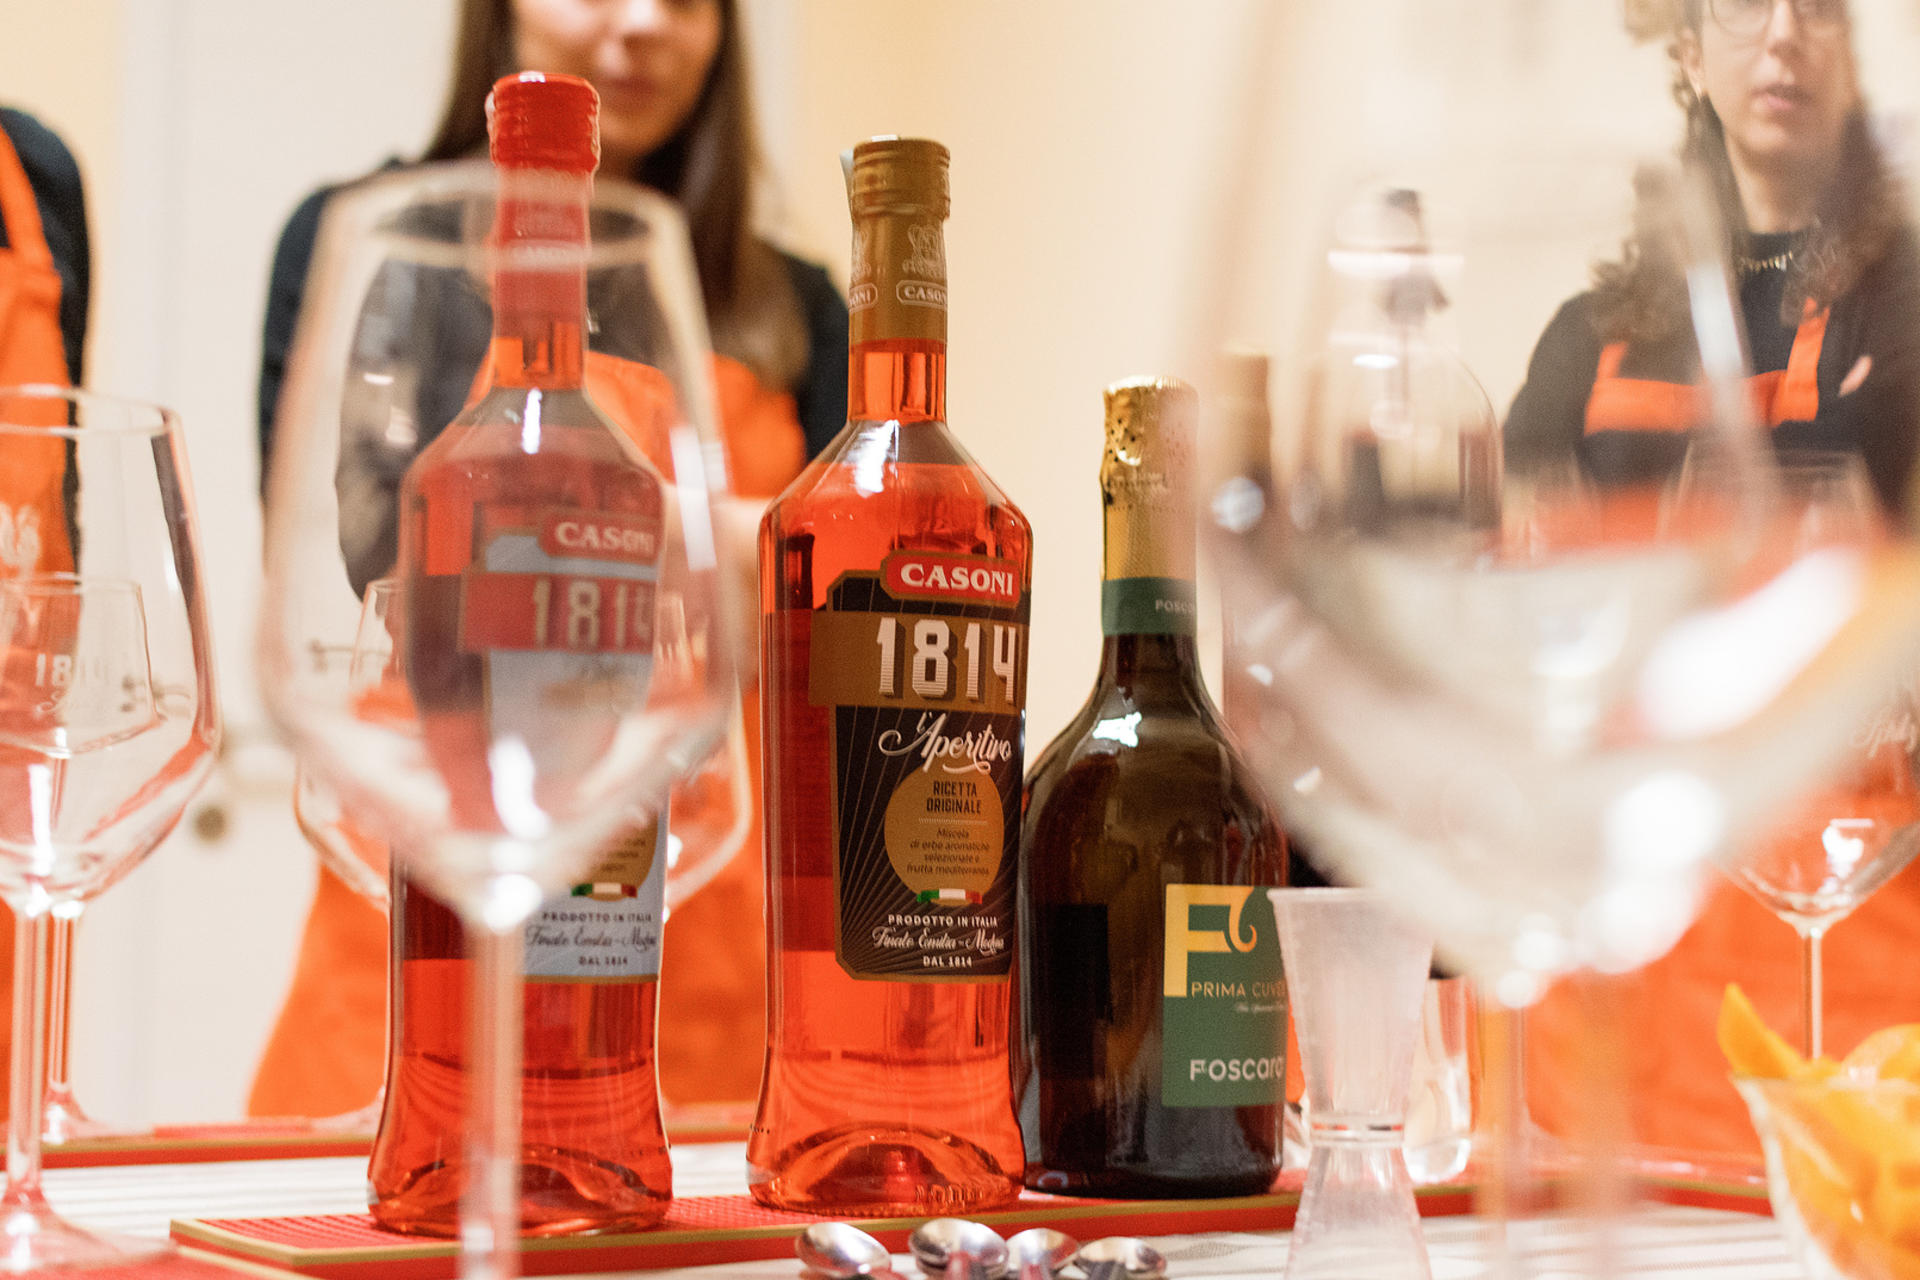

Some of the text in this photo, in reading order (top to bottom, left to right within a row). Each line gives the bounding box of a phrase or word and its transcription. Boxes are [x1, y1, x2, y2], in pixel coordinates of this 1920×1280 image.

[900, 563, 1014, 596] CASONI
[876, 617, 1017, 703] 1814
[932, 780, 977, 797] RICETTA
[926, 797, 982, 815] ORIGINALE
[542, 911, 610, 923] PRODOTTO
[614, 912, 624, 923] IN
[888, 914, 999, 928] PRODOTTO IN ITALIA
[922, 955, 973, 968] DAL 1814
[1191, 981, 1247, 998] PRIMA
